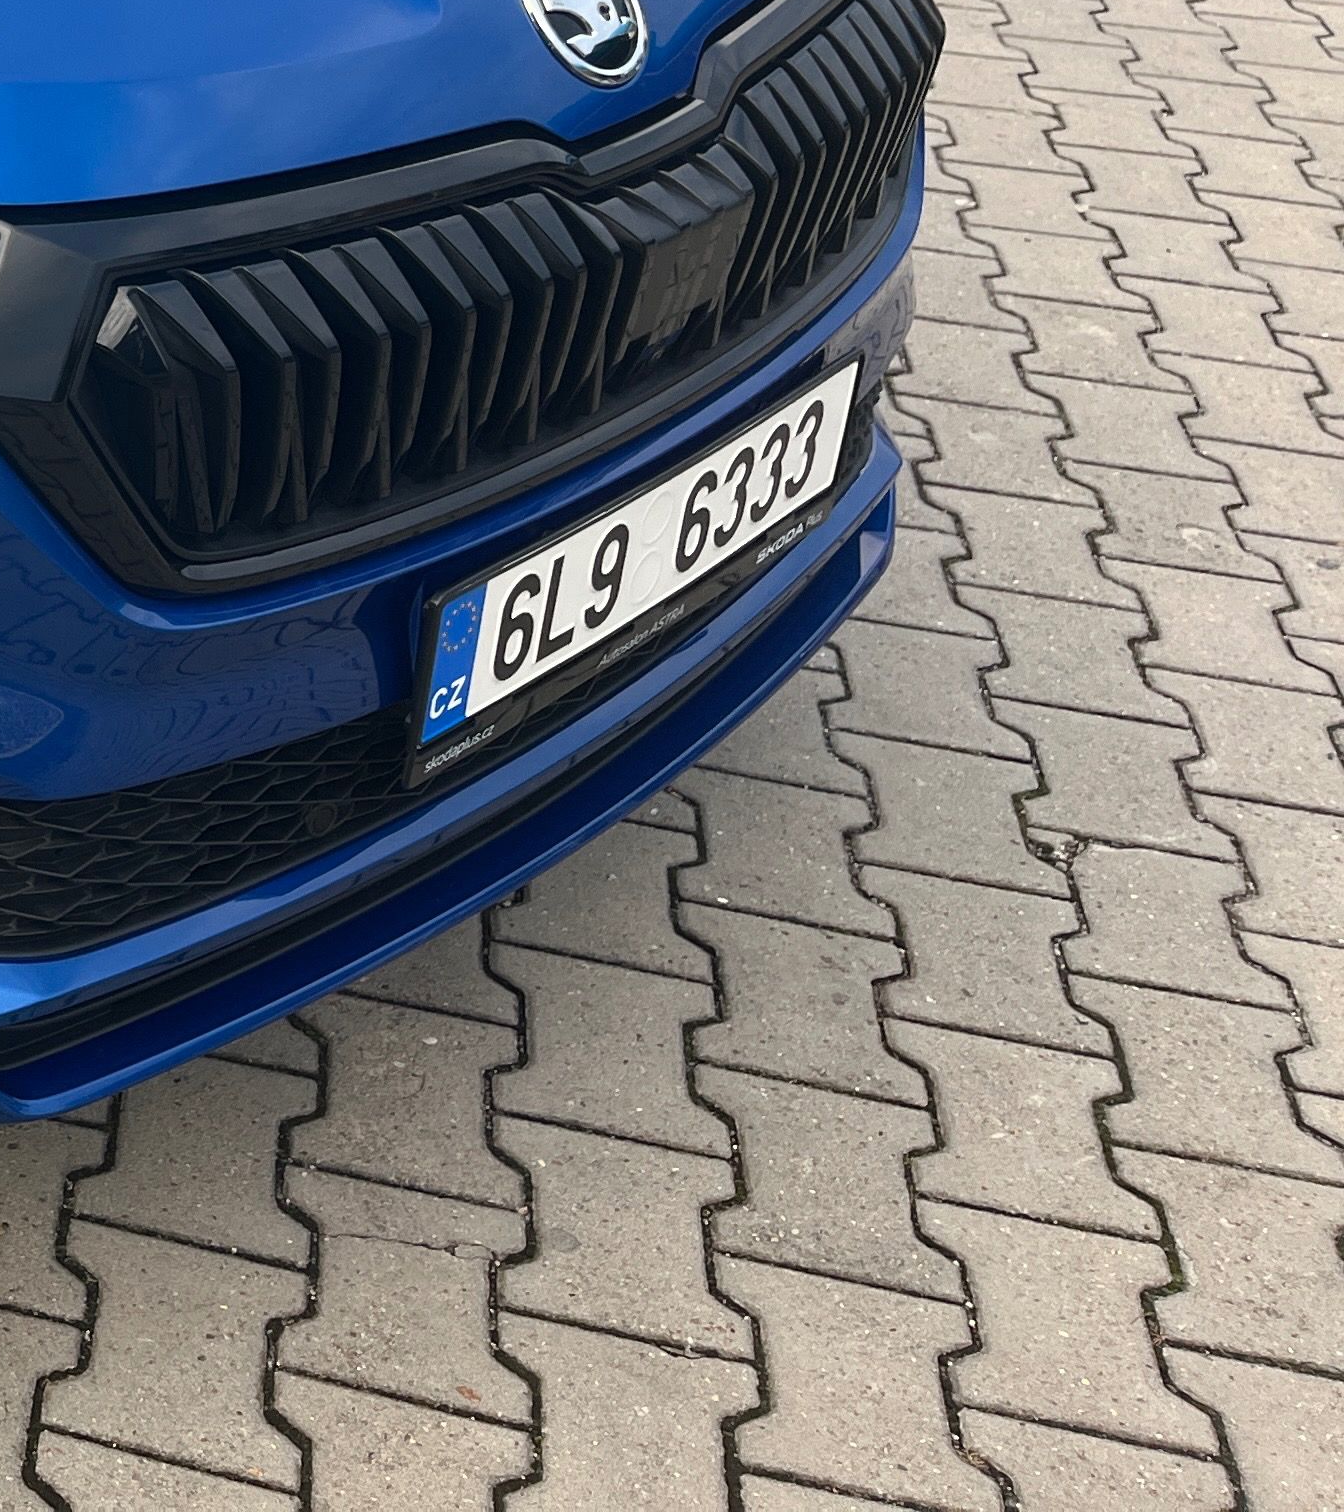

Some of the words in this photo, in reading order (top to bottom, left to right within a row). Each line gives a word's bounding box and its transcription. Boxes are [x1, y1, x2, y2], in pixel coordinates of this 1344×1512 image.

[492, 522, 630, 681] 6L9
[675, 399, 825, 574] 6333
[648, 603, 685, 636] ASTRA
[429, 675, 466, 720] CZ
[424, 724, 496, 774] skodaplus.cz
